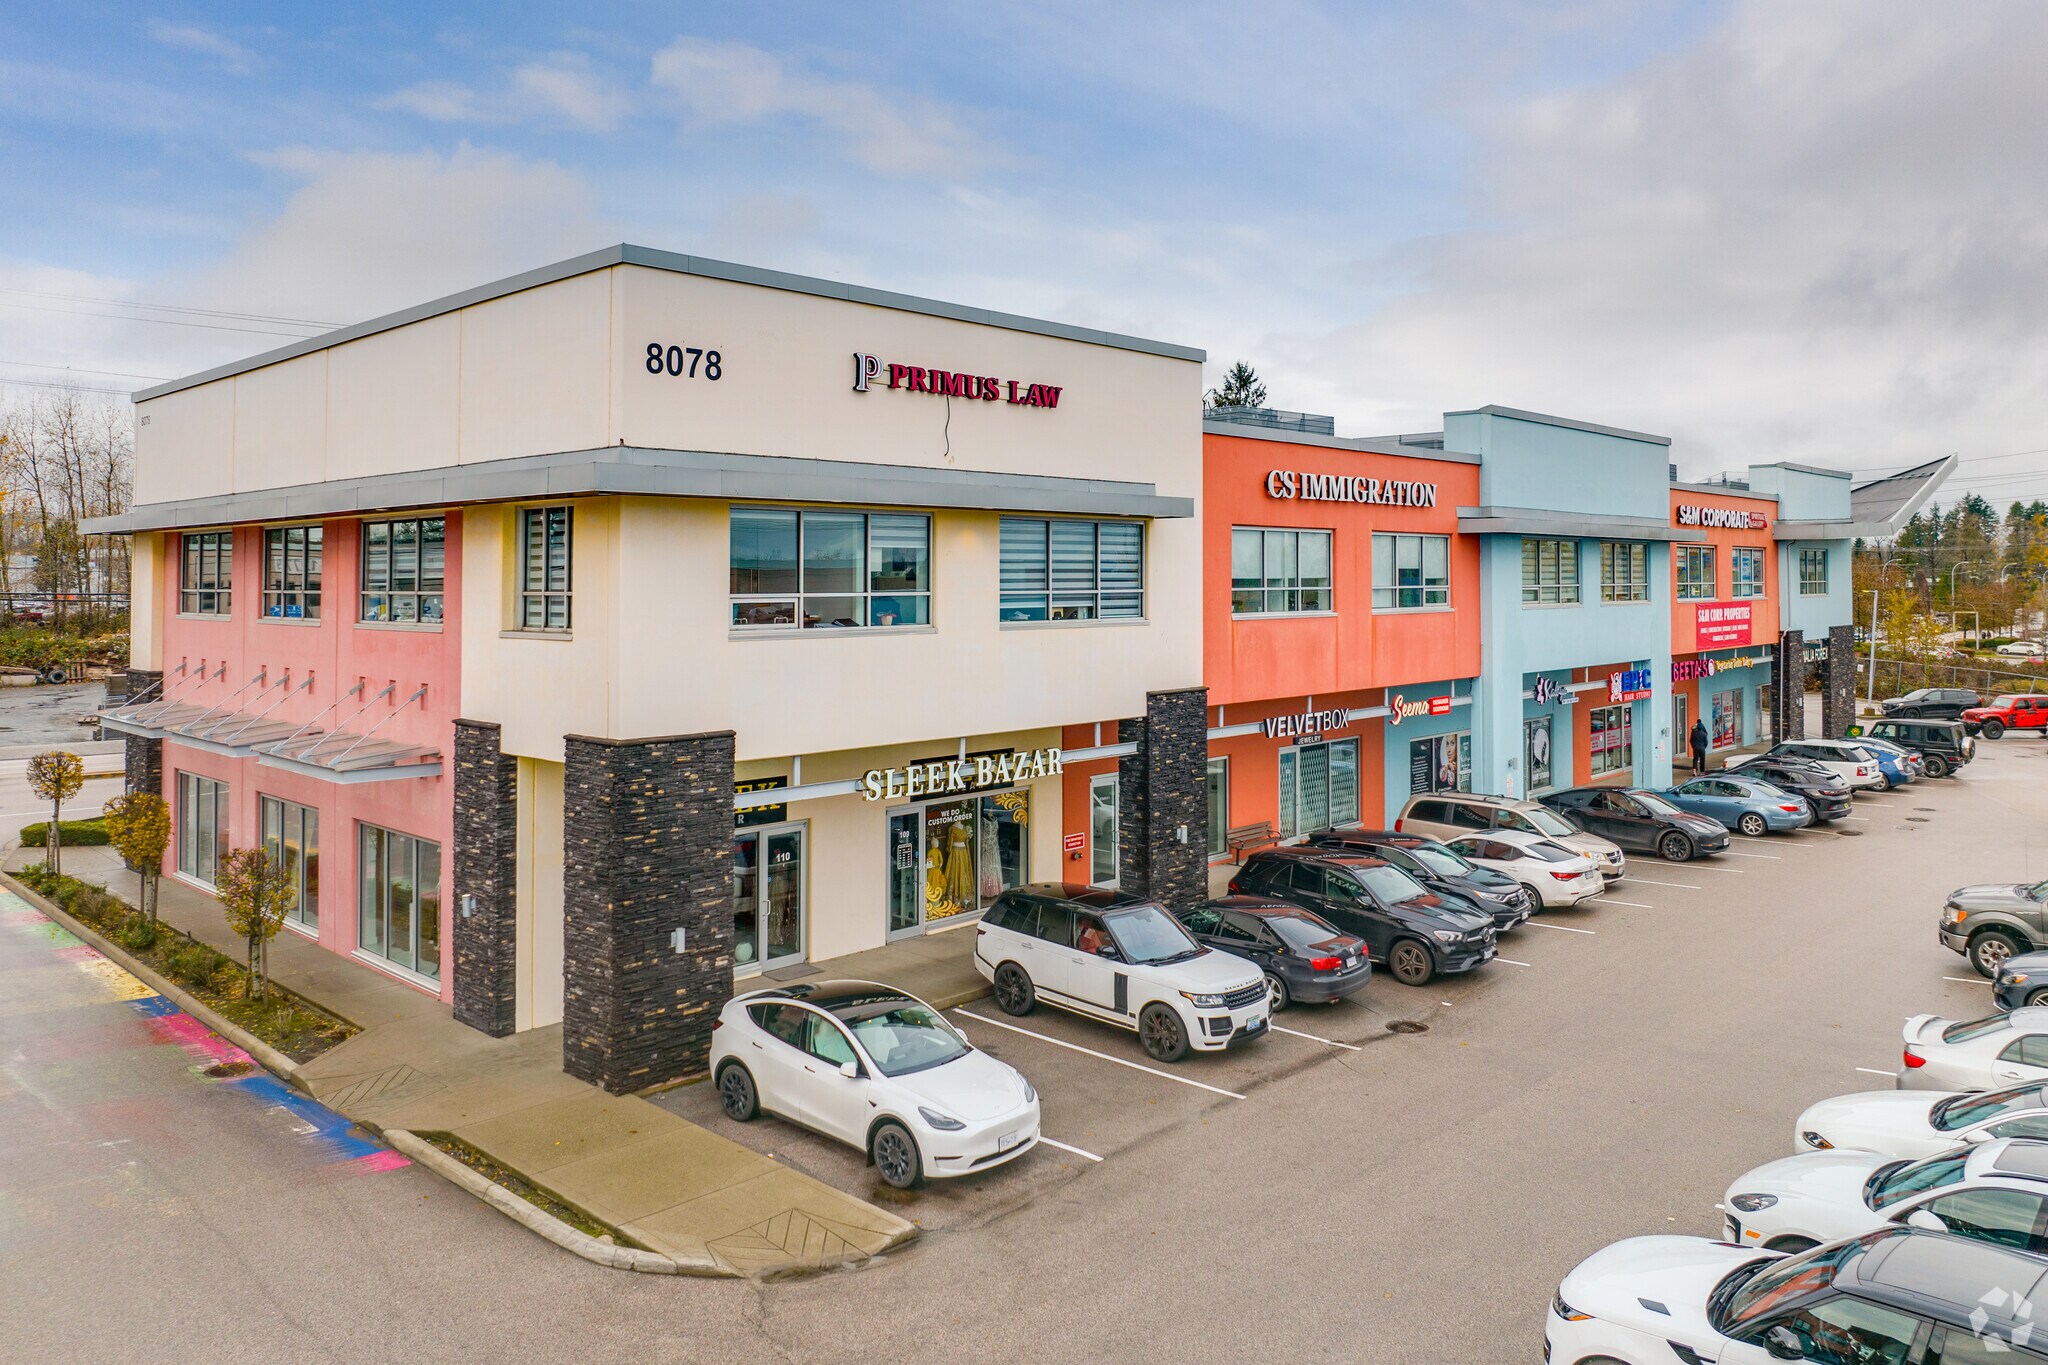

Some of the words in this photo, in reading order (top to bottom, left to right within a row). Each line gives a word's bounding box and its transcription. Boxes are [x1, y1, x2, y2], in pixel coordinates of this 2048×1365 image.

[646, 343, 722, 381] 8078
[888, 363, 999, 401] PRIMUS
[1007, 380, 1063, 408] LAW
[1265, 469, 1296, 499] CS
[1300, 472, 1438, 508] IMMIGRATION
[1678, 504, 1700, 526] S&M
[1701, 507, 1749, 529] CORPORATE
[1724, 606, 1750, 620] PROPERTIES
[1622, 669, 1651, 692] EPIC
[1673, 659, 1708, 681] GEETA'S
[1624, 693, 1635, 701] HAIR
[1391, 694, 1429, 725] Seema
[1265, 708, 1349, 739] VELVETBOX
[1298, 735, 1322, 745] JEWELRY
[864, 760, 966, 802] SLEEK
[976, 747, 1064, 788] BAZAR
[928, 816, 953, 826] CUSTOM
[953, 812, 973, 822] ORDER
[951, 808, 960, 816] DO
[900, 830, 910, 838] 109
[775, 851, 791, 862] 110
